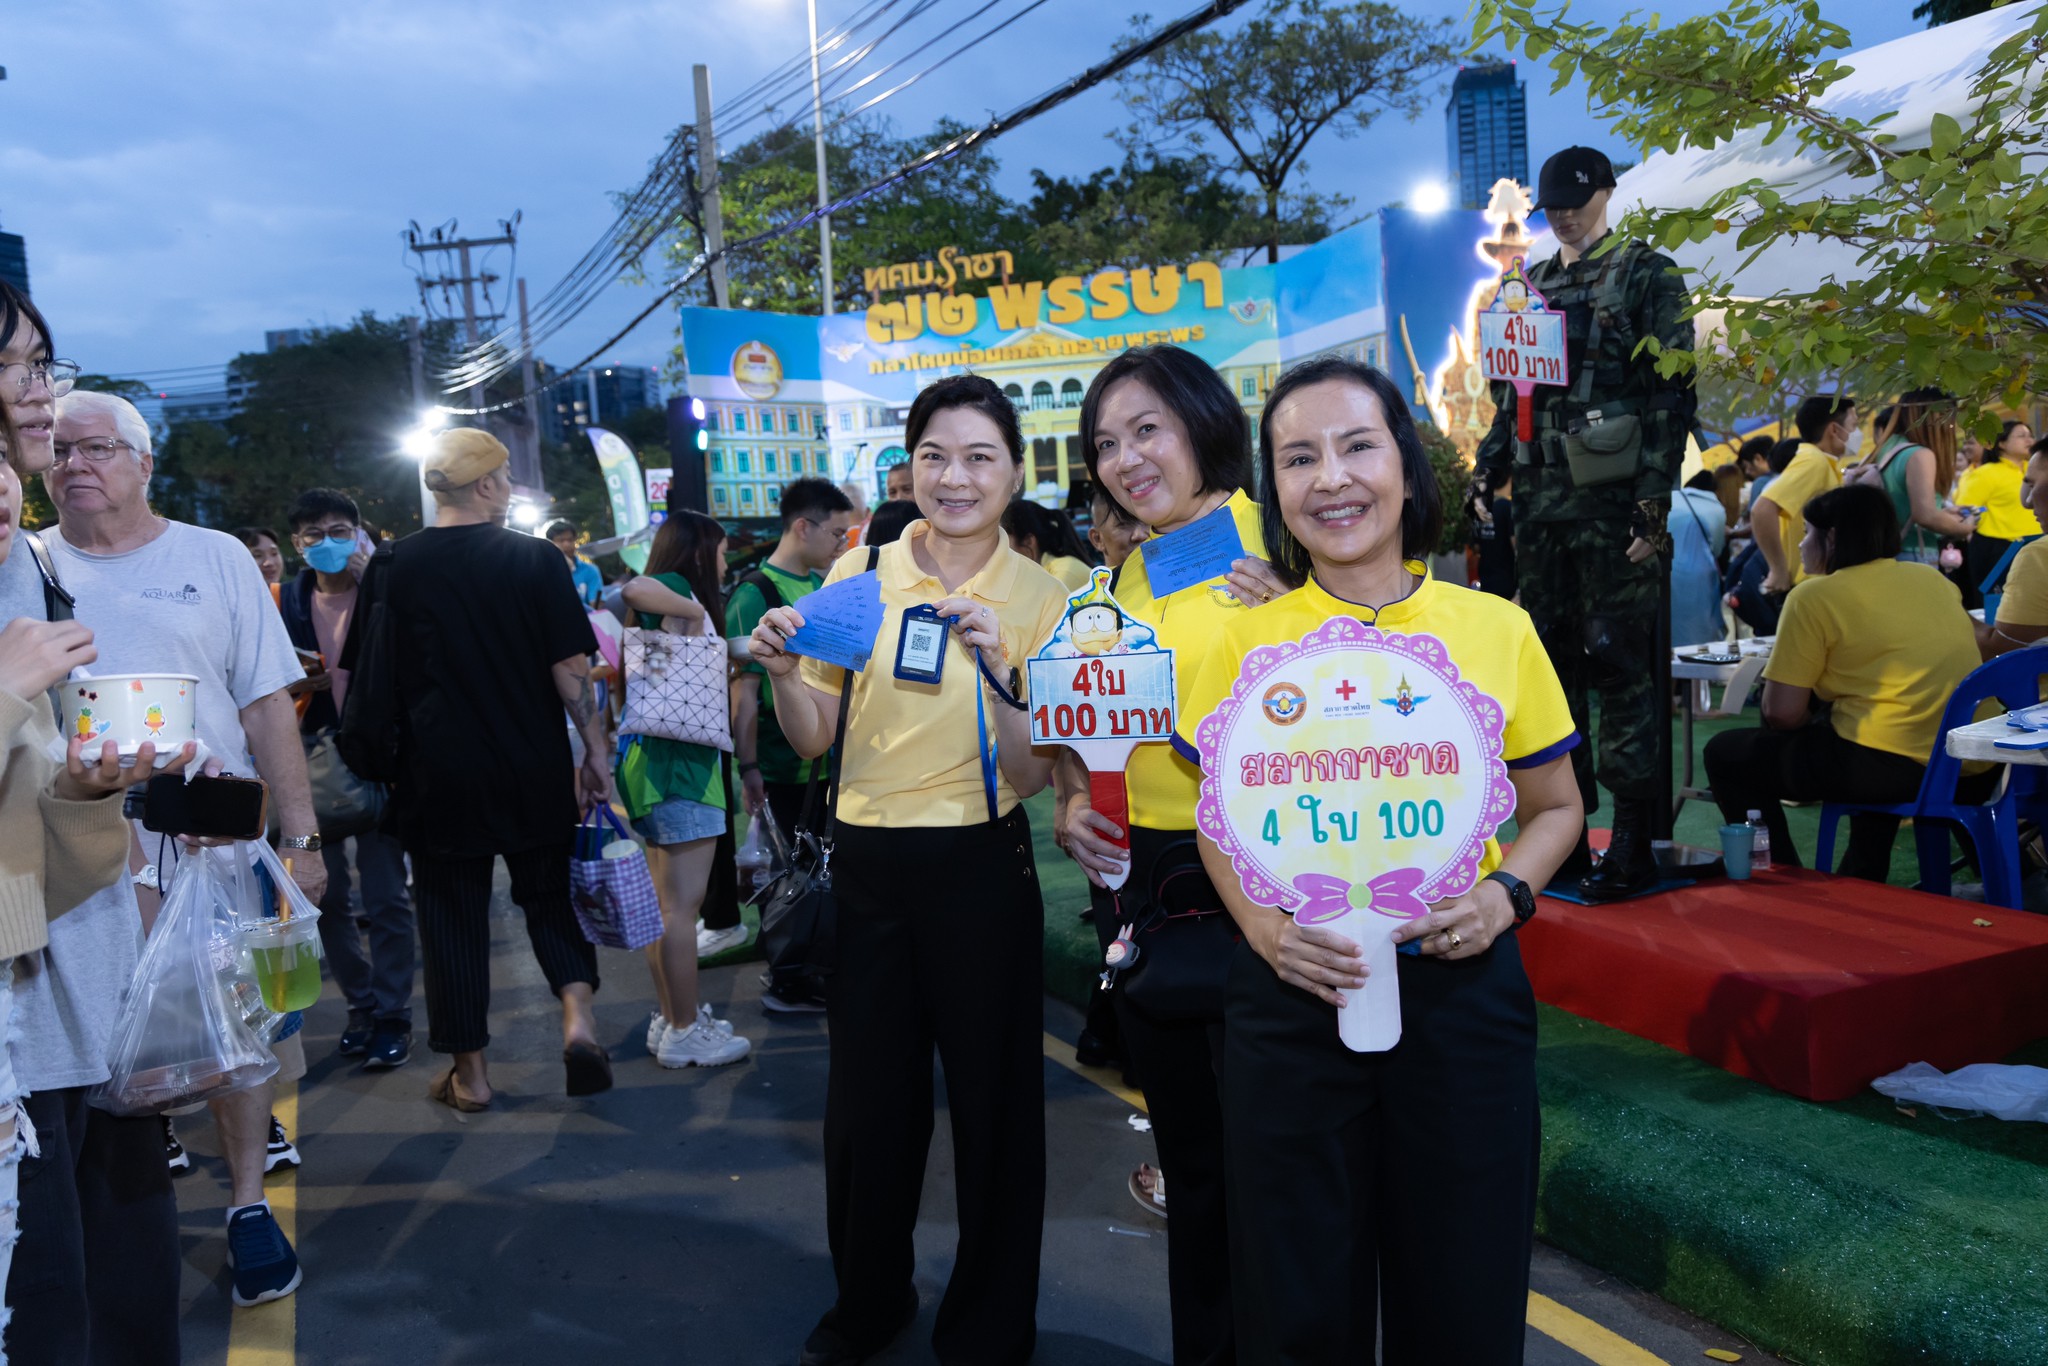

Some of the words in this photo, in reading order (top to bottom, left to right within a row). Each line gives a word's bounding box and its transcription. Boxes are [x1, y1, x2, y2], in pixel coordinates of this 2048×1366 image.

[987, 261, 1224, 331] พรรษา
[1504, 315, 1537, 346] 4ใบ
[1486, 347, 1520, 377] 100
[1525, 355, 1561, 380] บาท
[1072, 659, 1126, 697] 4ใบ
[1034, 703, 1097, 737] 100
[1108, 707, 1172, 735] บาท
[1240, 741, 1460, 787] สลากกาชาด
[1262, 808, 1281, 846] 4
[1296, 794, 1359, 843] ใบ
[1378, 799, 1444, 840] 100
